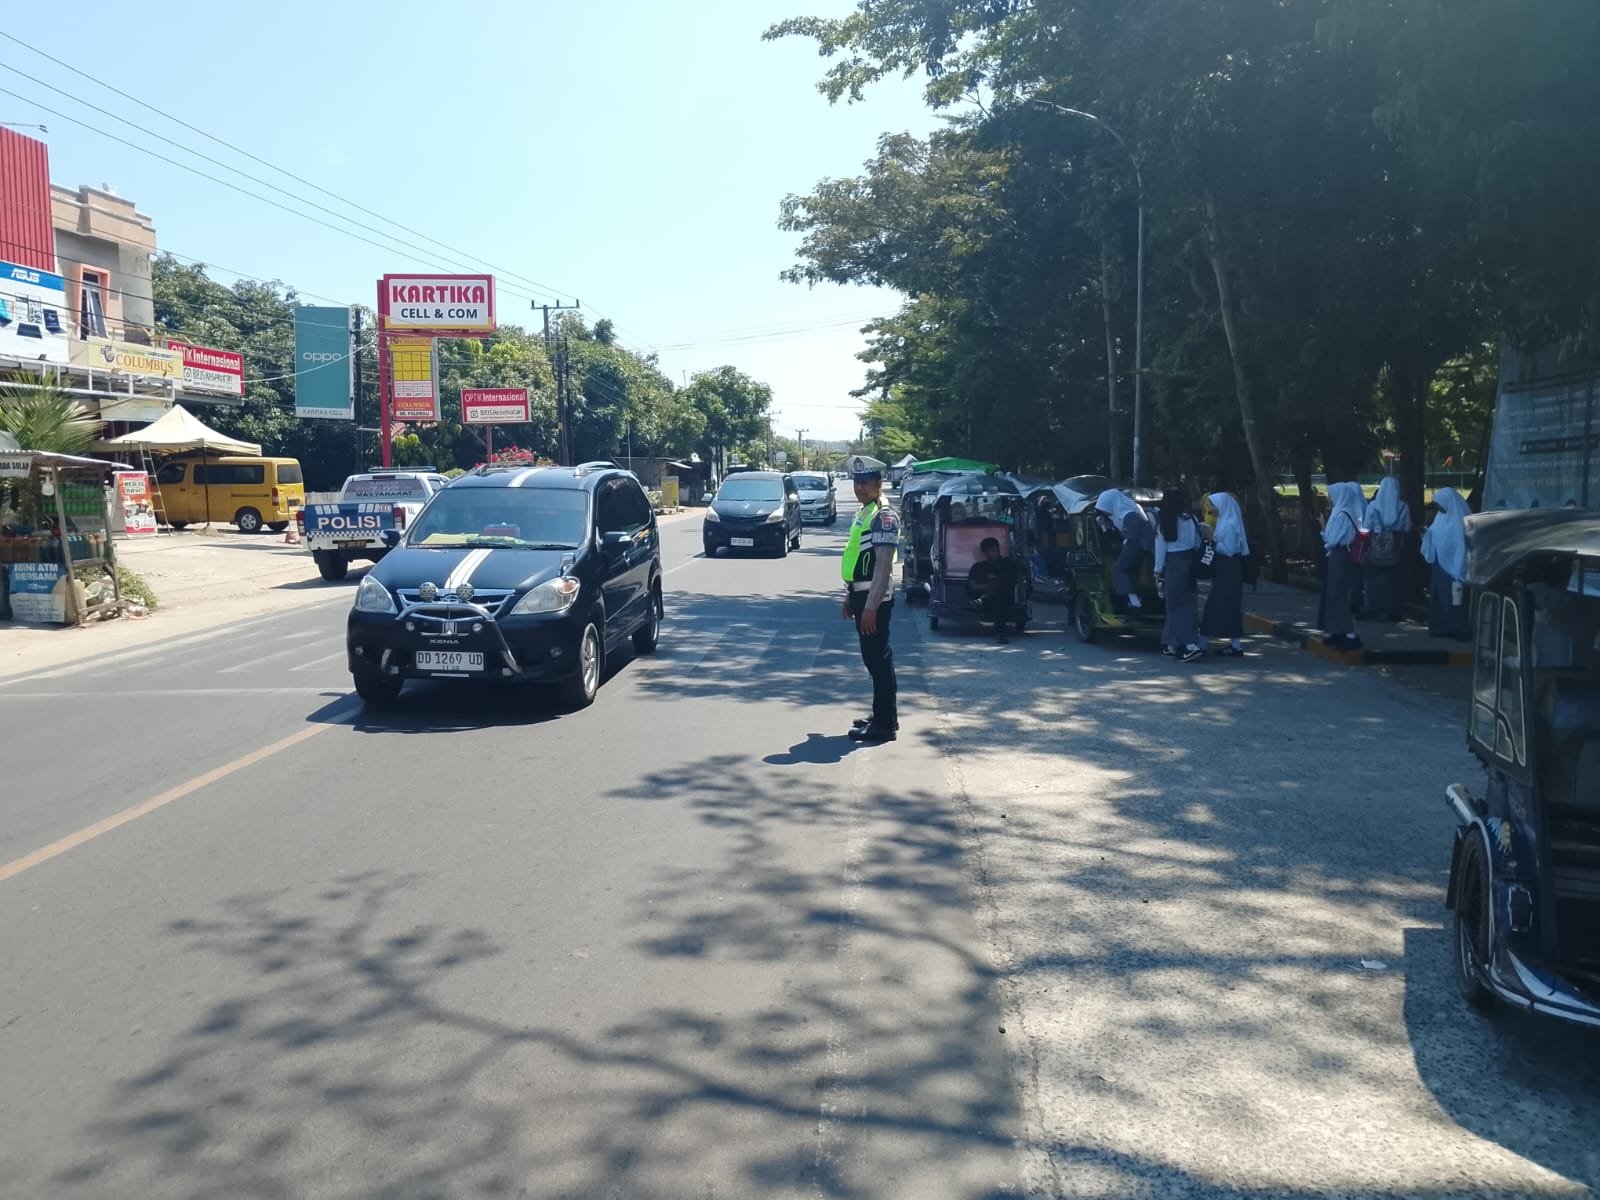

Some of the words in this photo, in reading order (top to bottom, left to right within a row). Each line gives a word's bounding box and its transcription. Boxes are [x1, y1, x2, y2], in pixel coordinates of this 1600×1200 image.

[11, 268, 40, 284] ASUS
[392, 285, 485, 304] KARTIKA
[401, 308, 430, 319] CELL
[434, 308, 444, 319] &
[447, 308, 478, 319] COM
[115, 353, 174, 373] COLUMBUS
[193, 349, 241, 371] Internasional
[303, 352, 341, 363] oppo
[482, 392, 526, 401] Internasional
[317, 515, 381, 530] POLISI
[14, 563, 35, 572] MINI
[38, 563, 58, 572] ATM
[15, 572, 58, 580] BERSAMA
[417, 652, 431, 664] DD
[435, 652, 462, 665] 1269
[468, 654, 482, 666] UD
